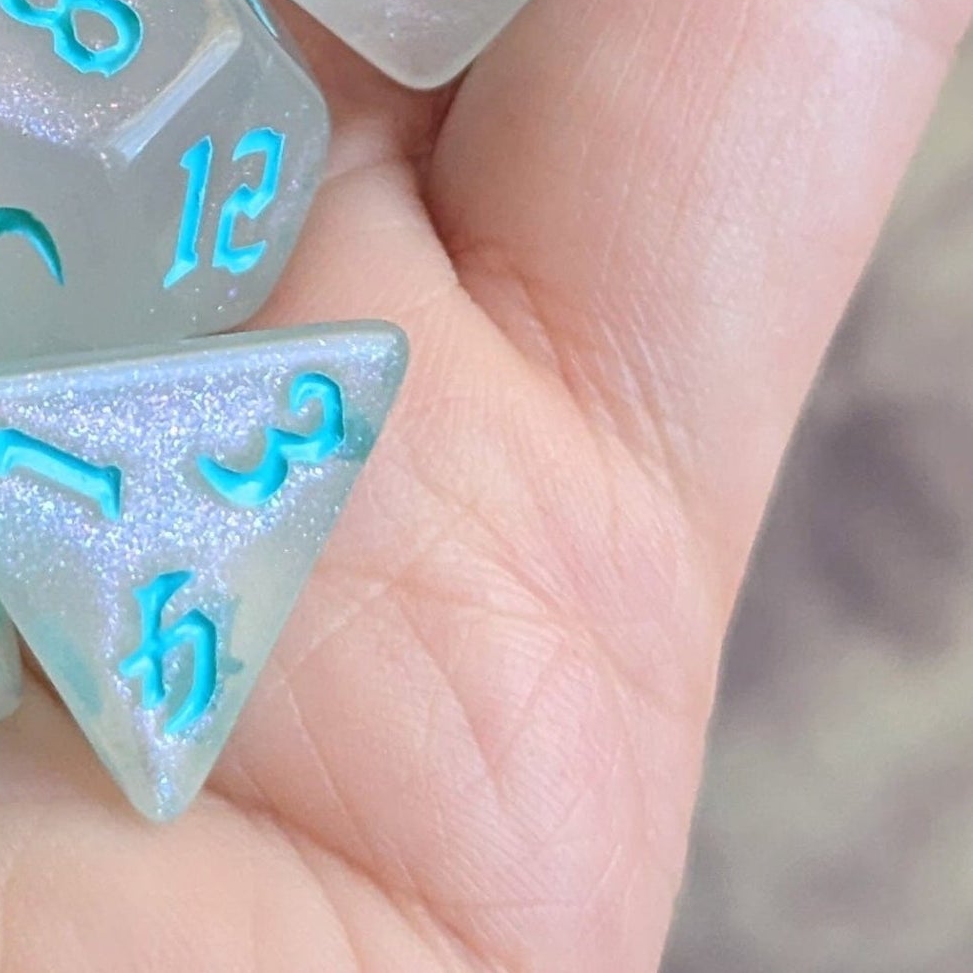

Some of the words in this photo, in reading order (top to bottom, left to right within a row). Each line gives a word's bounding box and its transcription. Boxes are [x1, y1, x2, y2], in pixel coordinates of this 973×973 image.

[163, 126, 285, 289] 12
[197, 372, 346, 508] 3
[119, 569, 219, 734] 4
